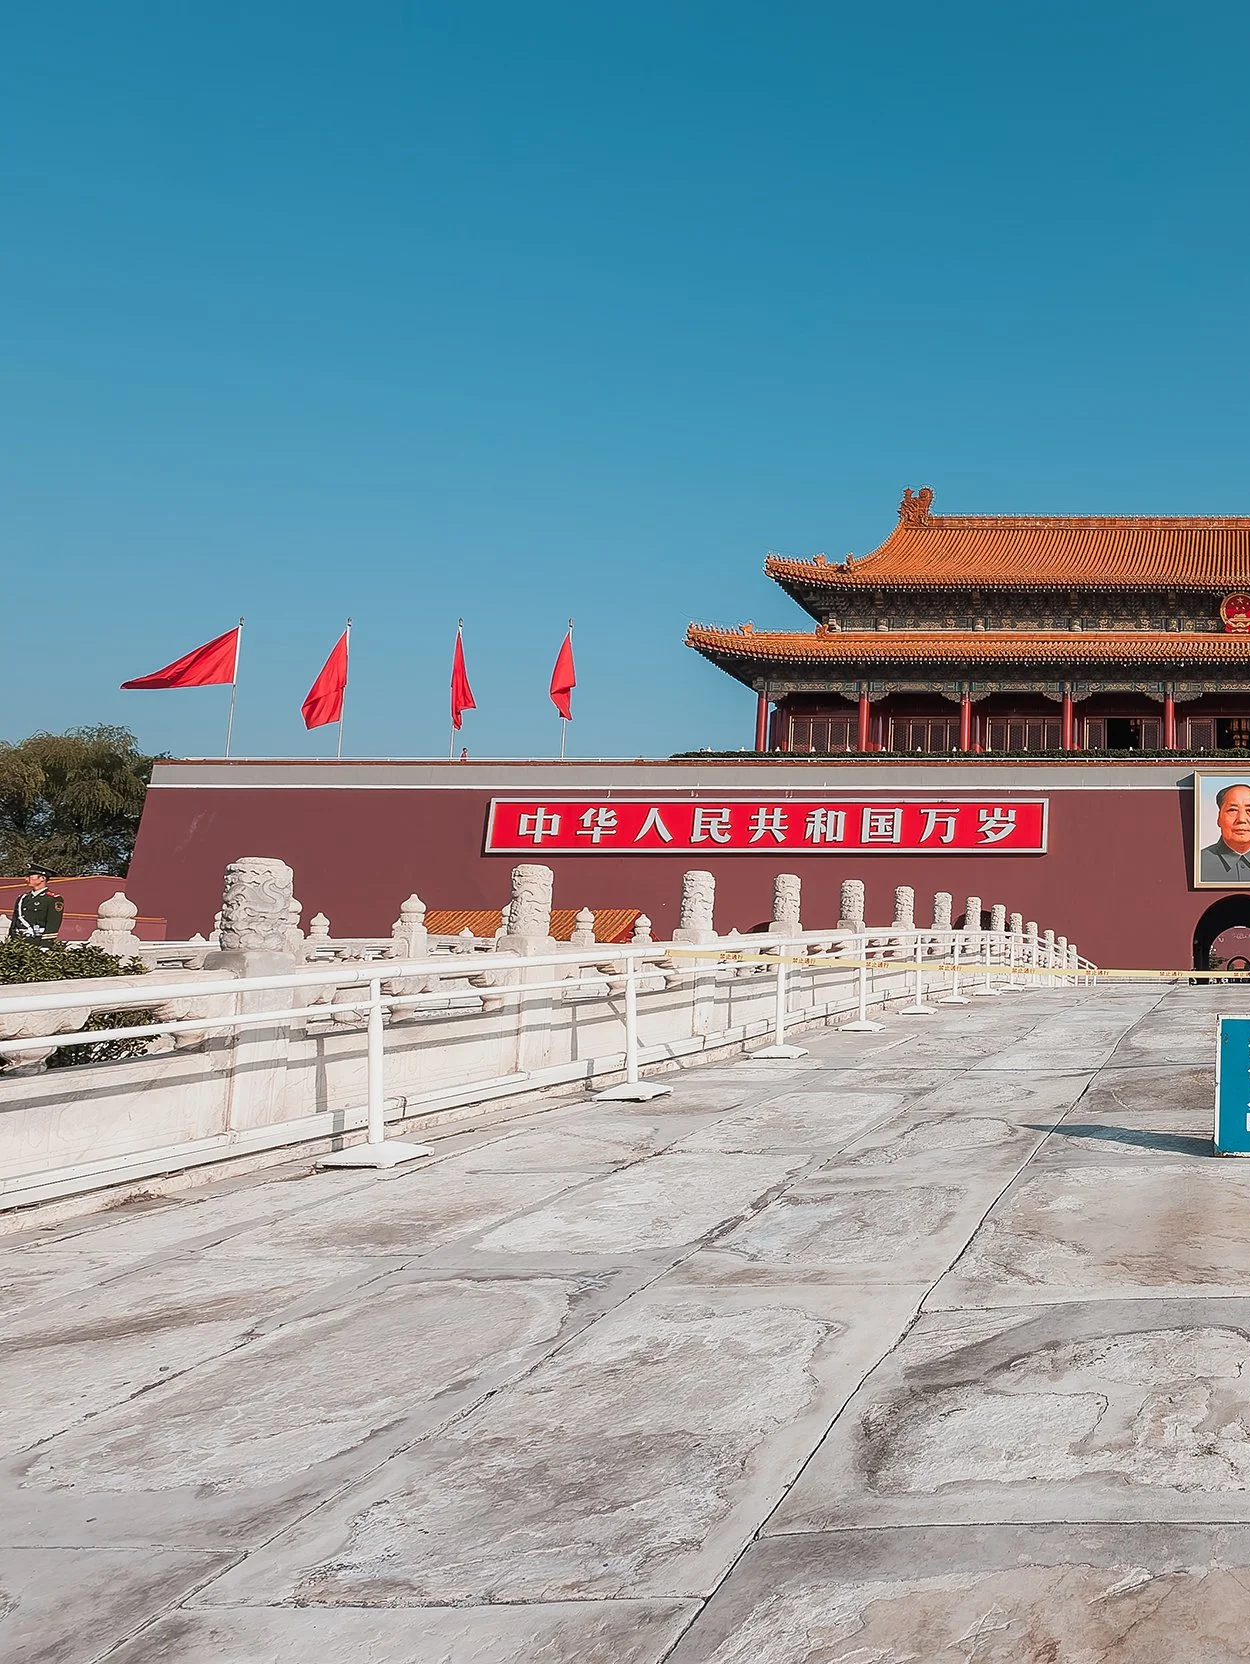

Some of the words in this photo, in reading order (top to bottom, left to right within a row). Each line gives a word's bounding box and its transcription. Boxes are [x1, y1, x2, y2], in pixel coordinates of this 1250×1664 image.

[518, 807, 1017, 844] 中华人民共和国万岁
[720, 953, 743, 961] 禁止通行
[792, 957, 816, 965] 禁止通行
[865, 961, 889, 969] 禁止通行
